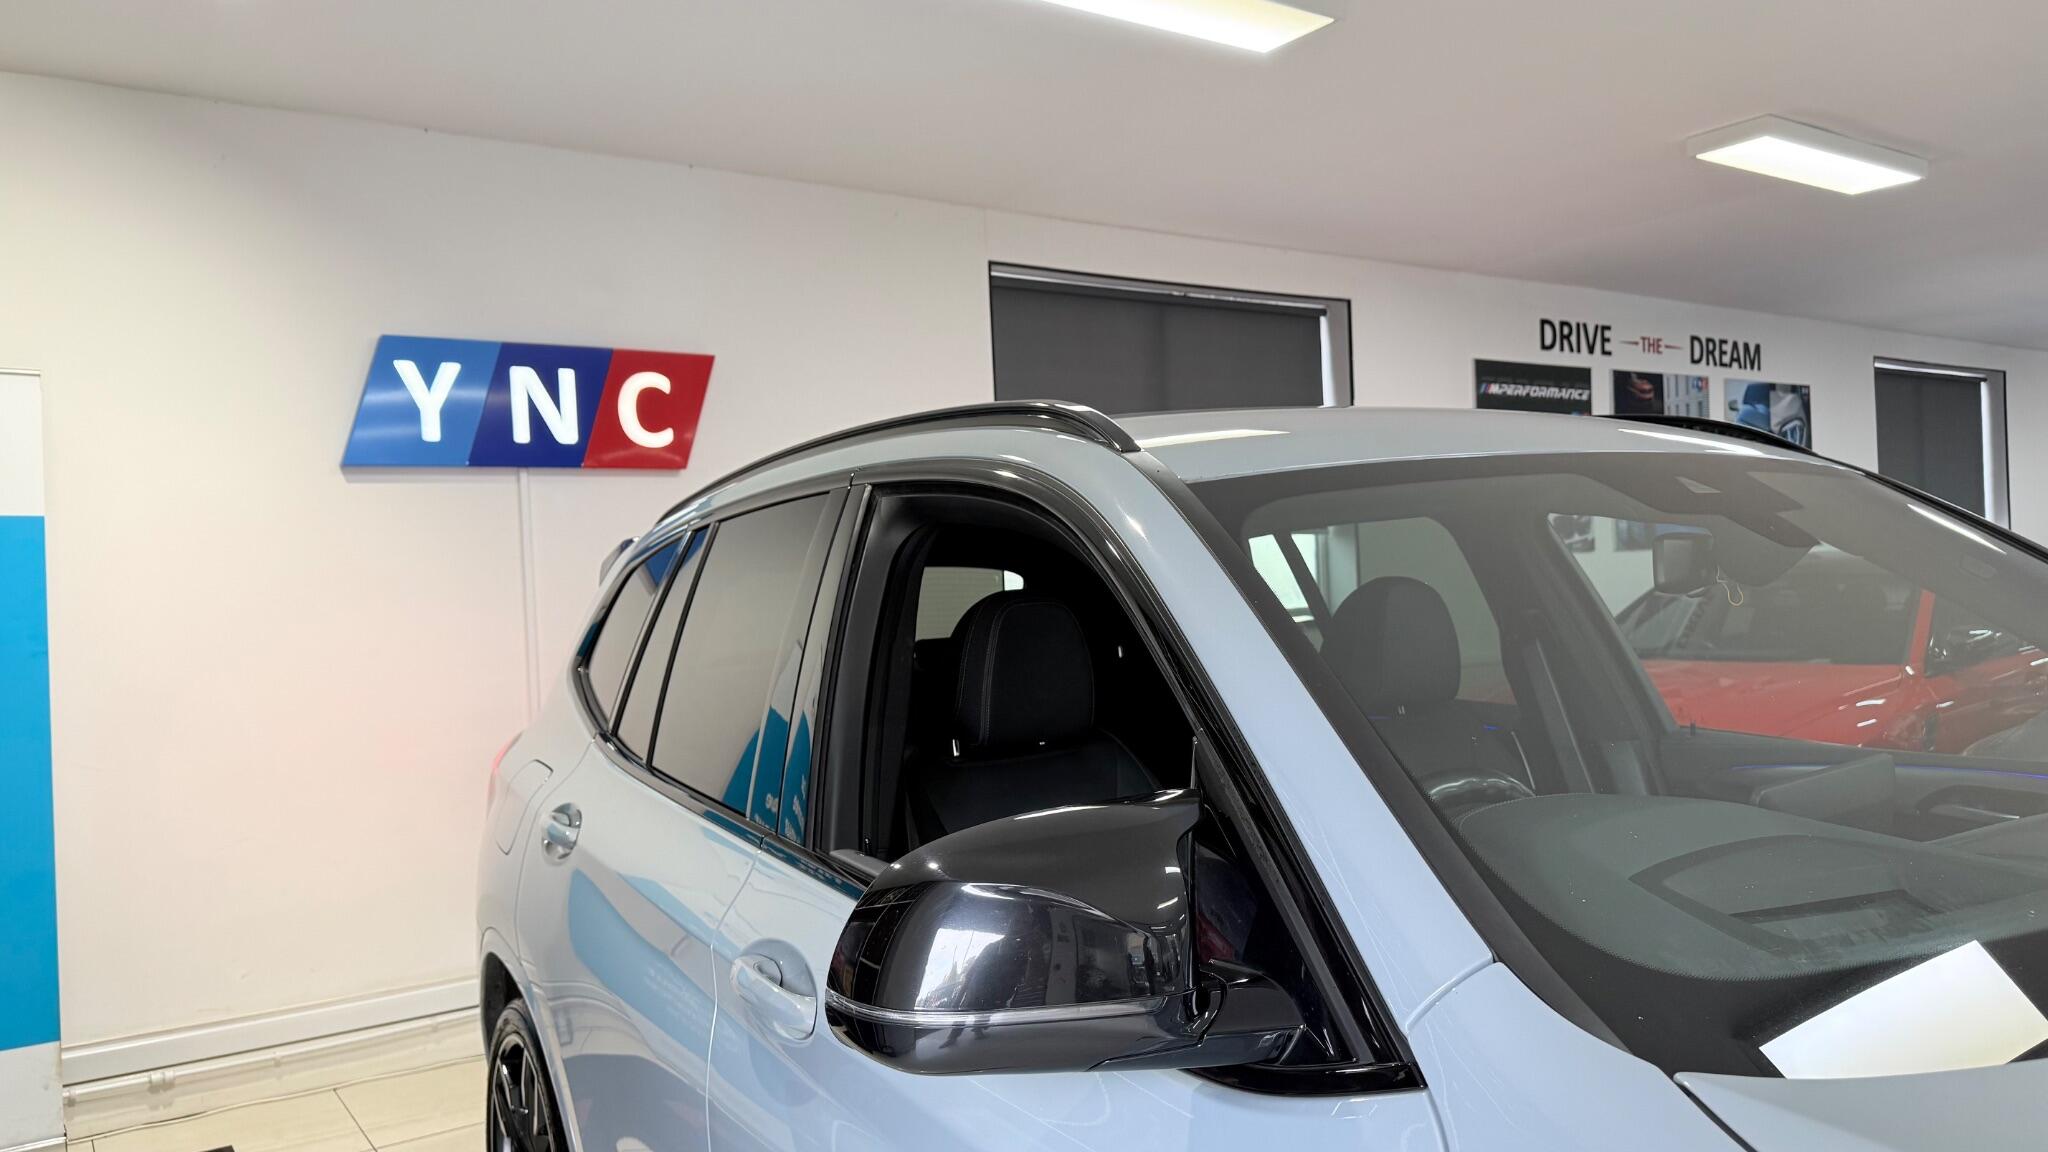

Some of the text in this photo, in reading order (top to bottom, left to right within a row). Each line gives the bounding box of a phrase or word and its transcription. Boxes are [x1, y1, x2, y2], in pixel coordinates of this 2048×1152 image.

[1540, 318, 1761, 371] DRIVE THE DREAM
[393, 360, 674, 448] YNC
